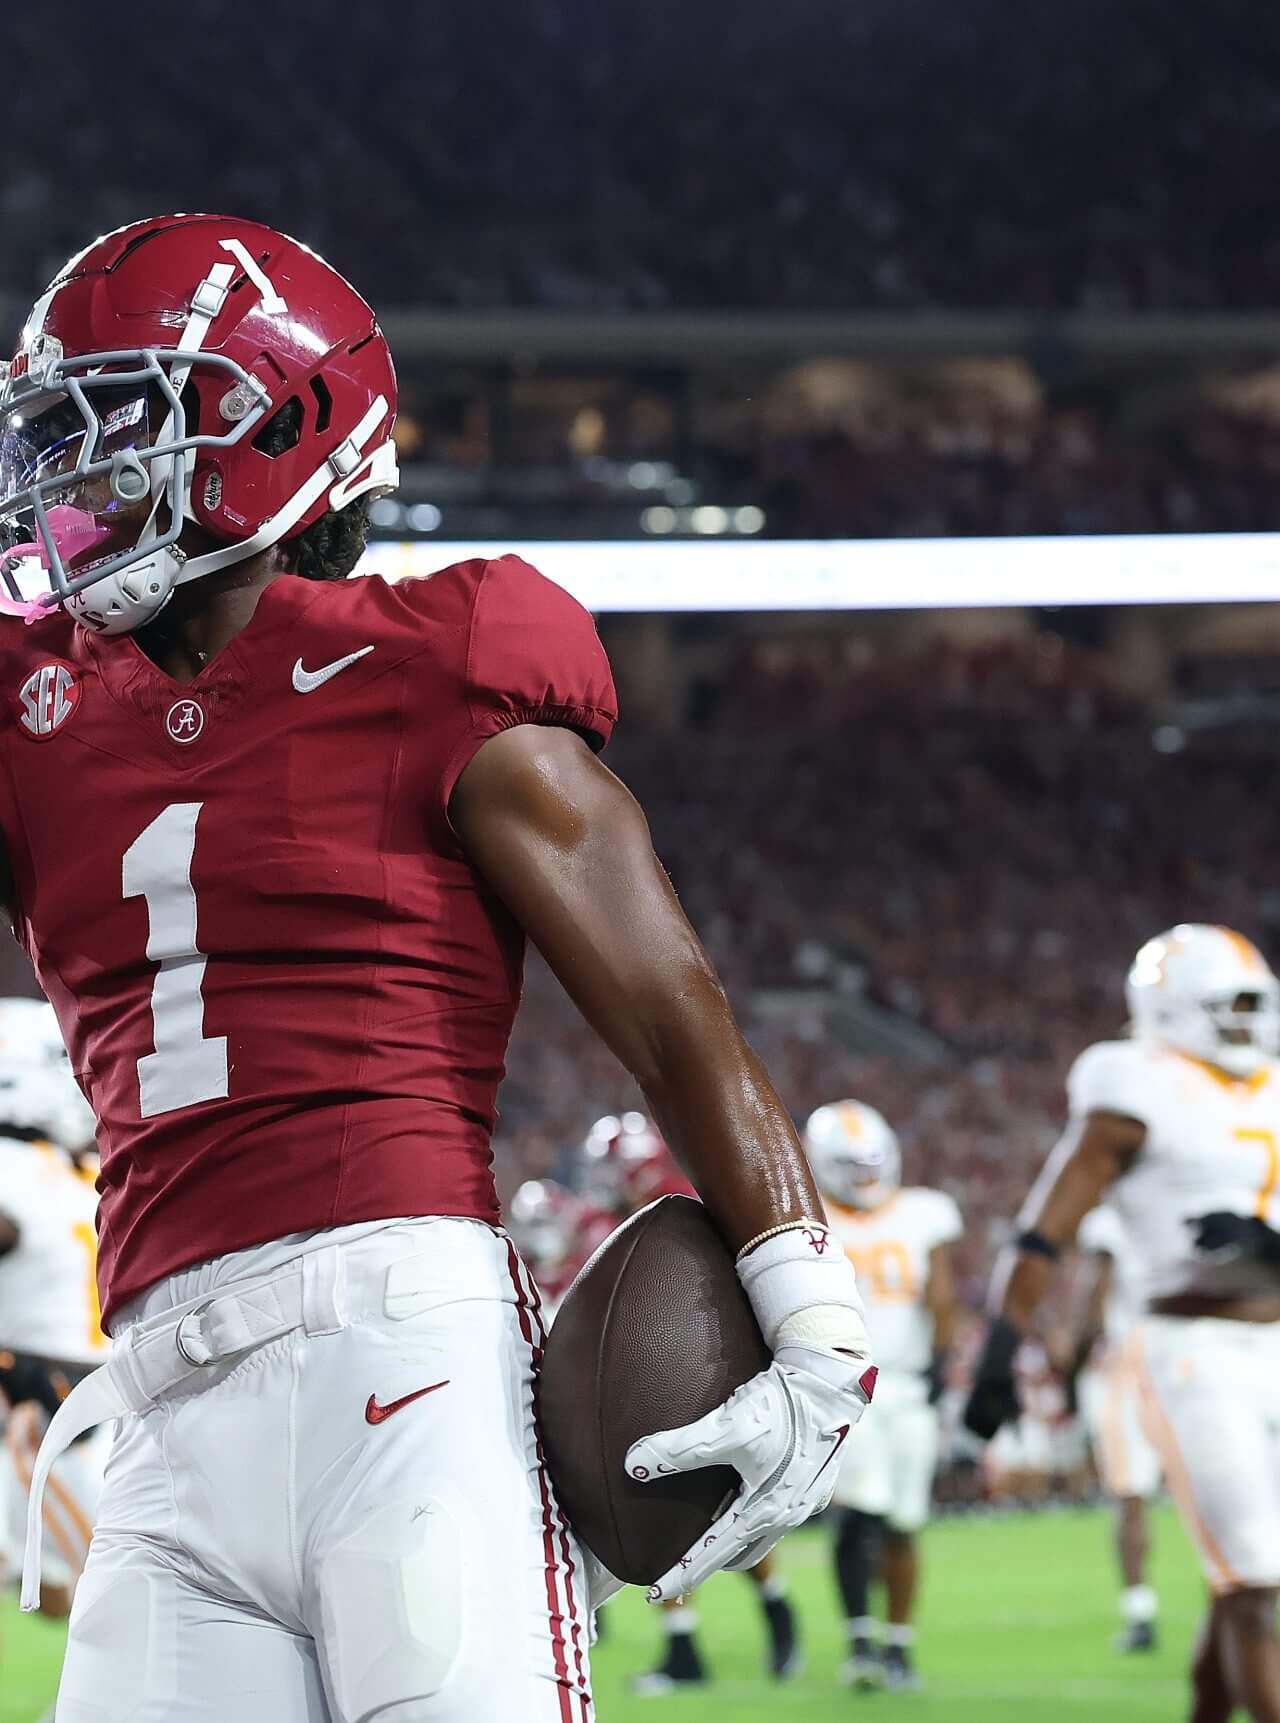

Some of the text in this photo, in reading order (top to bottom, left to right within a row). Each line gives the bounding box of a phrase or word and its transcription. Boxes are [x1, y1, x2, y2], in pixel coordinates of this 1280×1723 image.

[217, 238, 289, 315] 1
[19, 664, 76, 735] SEC
[122, 801, 230, 1120] 1
